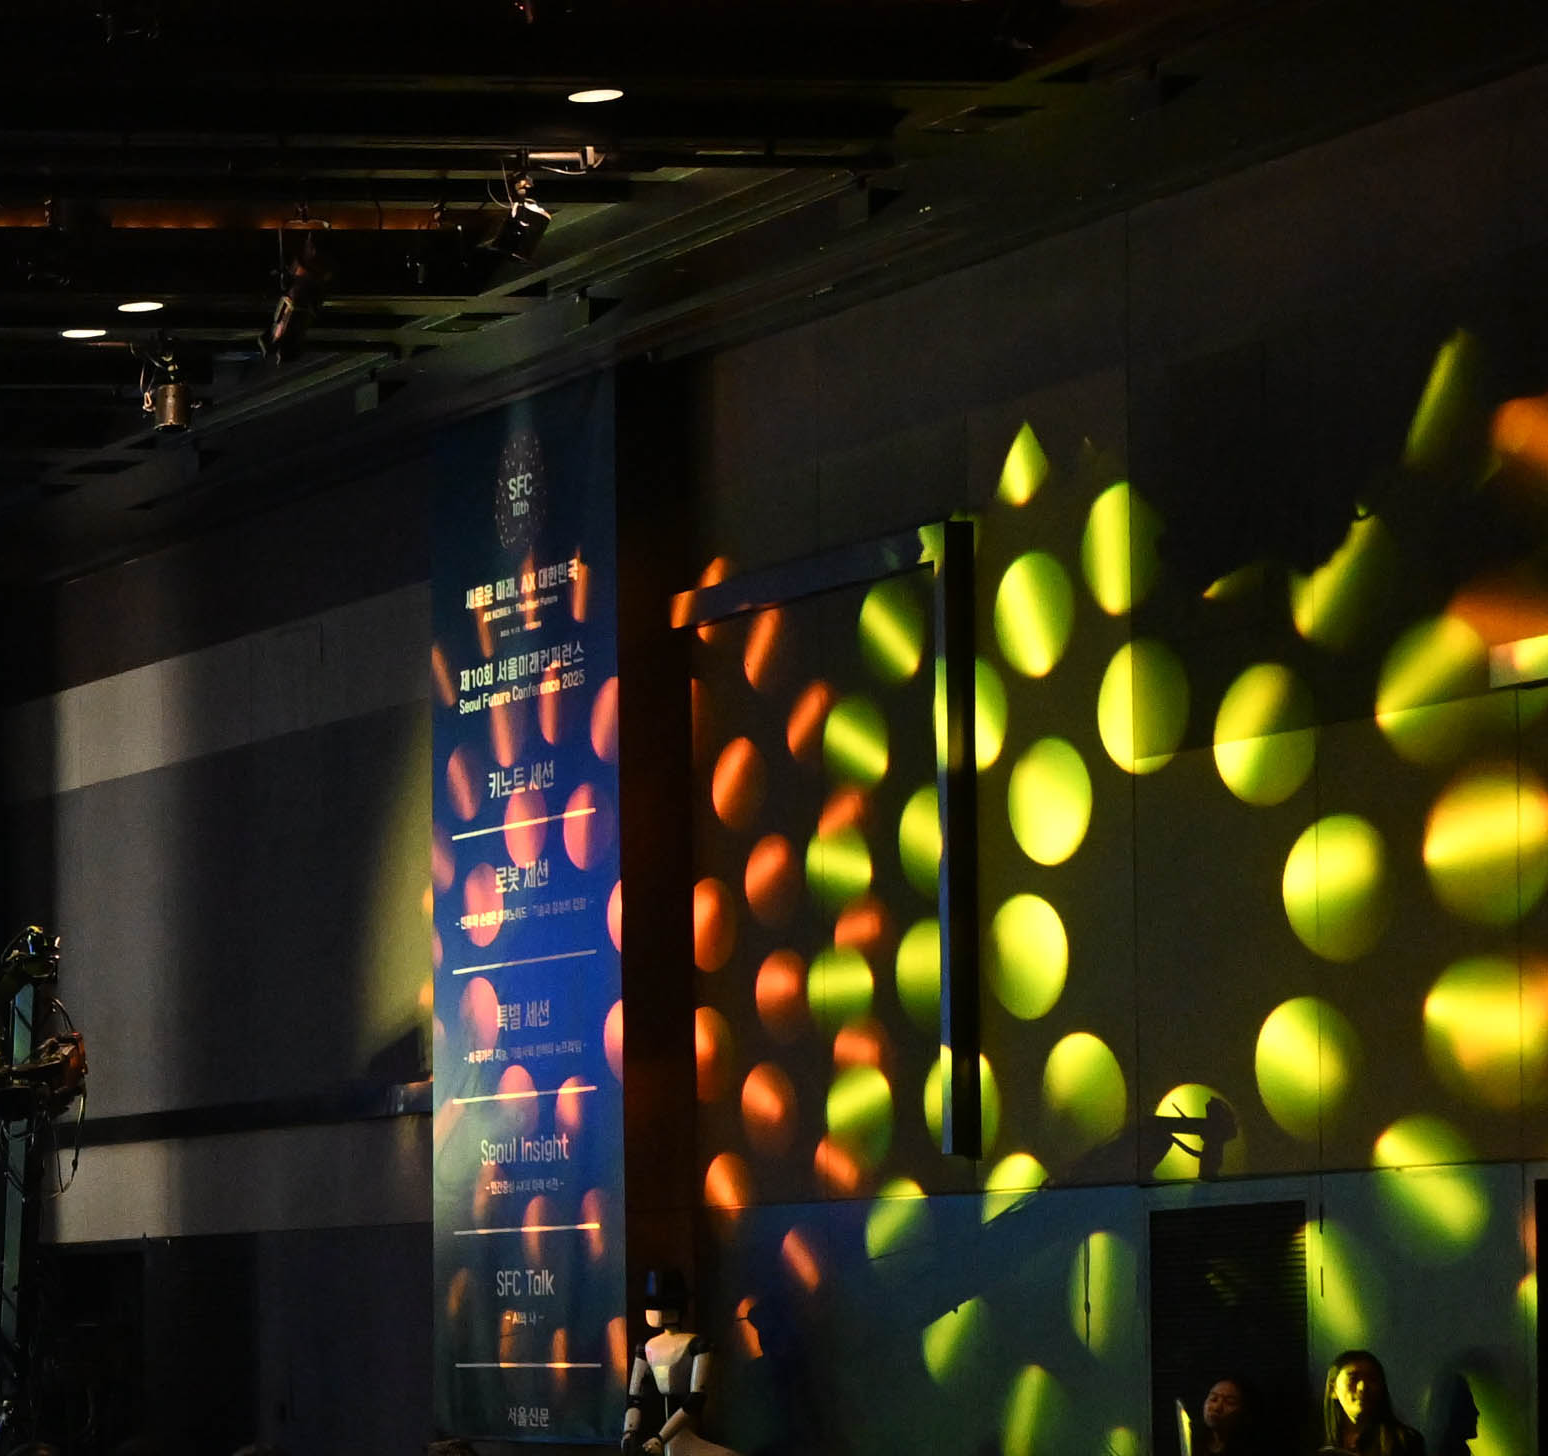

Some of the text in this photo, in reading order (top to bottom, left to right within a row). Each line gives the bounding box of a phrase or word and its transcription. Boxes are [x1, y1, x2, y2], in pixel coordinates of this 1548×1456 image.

[508, 473, 533, 501] SFC
[512, 500, 529, 517] 10th
[465, 584, 494, 609] 새로운
[496, 577, 519, 600] 미래,
[521, 572, 536, 594] AX
[538, 558, 578, 589] 대한민국
[460, 640, 584, 692] 제10회 서울미래컨퍼런스
[459, 669, 585, 715] Seoul Future Conference 2025
[488, 760, 554, 799] 키노트 세션
[495, 858, 549, 894] 로봇 세션
[497, 999, 550, 1032] 특별 세션
[480, 1133, 569, 1166] Seoul Insight
[496, 1269, 555, 1297] SFC Talk
[508, 1406, 549, 1428] 서울신문
